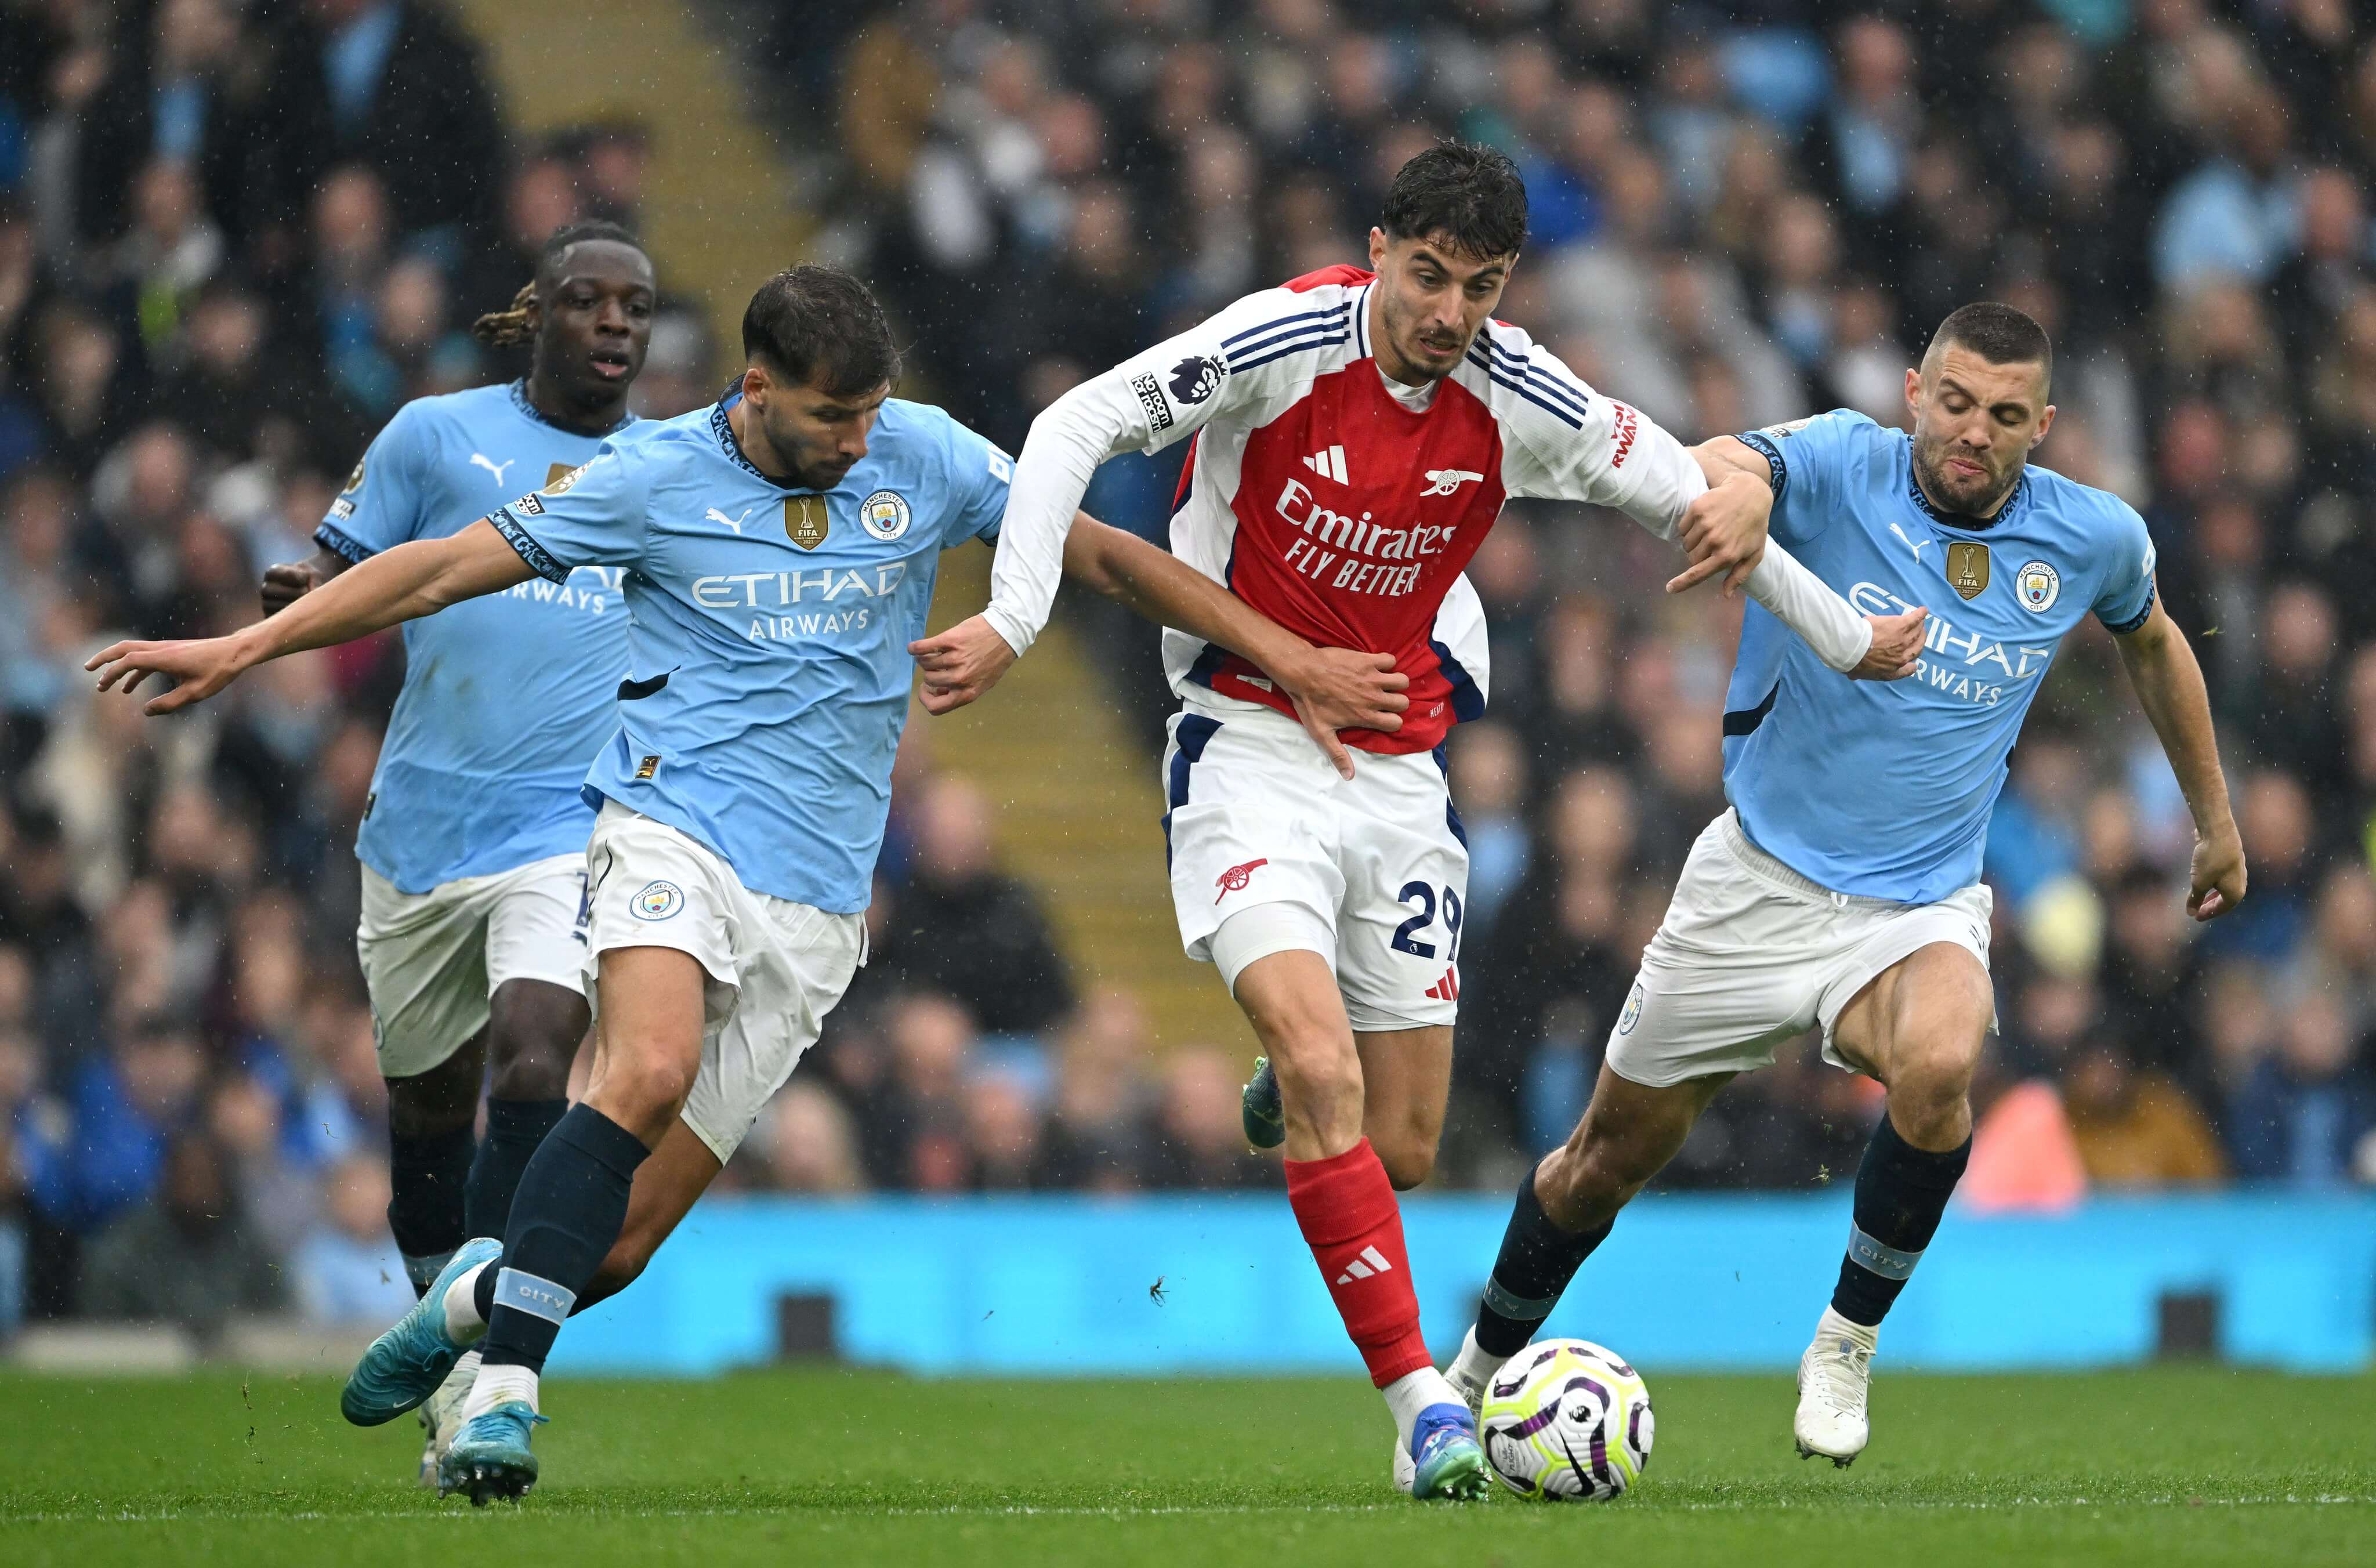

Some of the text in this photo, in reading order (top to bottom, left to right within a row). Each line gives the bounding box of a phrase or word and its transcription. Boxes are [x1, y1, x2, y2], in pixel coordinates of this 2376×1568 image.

[1140, 394, 1162, 433] racism
[1141, 371, 1170, 425] No room
[1609, 400, 1625, 439] VISI
[1612, 407, 1637, 469] RWAN
[863, 494, 903, 512] MANCHESTER
[1276, 477, 1457, 560] Emirates
[691, 561, 907, 607] ETIHAD
[1284, 538, 1421, 596] FLY BETTER
[2020, 564, 2056, 582] MANCHESTER
[493, 578, 604, 614] RWAYS
[749, 609, 868, 640] AIRWAYS
[1911, 657, 2001, 706] RWAYS
[1390, 881, 1462, 962] 29
[1860, 1245, 1907, 1269] CITY
[519, 1286, 565, 1309] CITY
